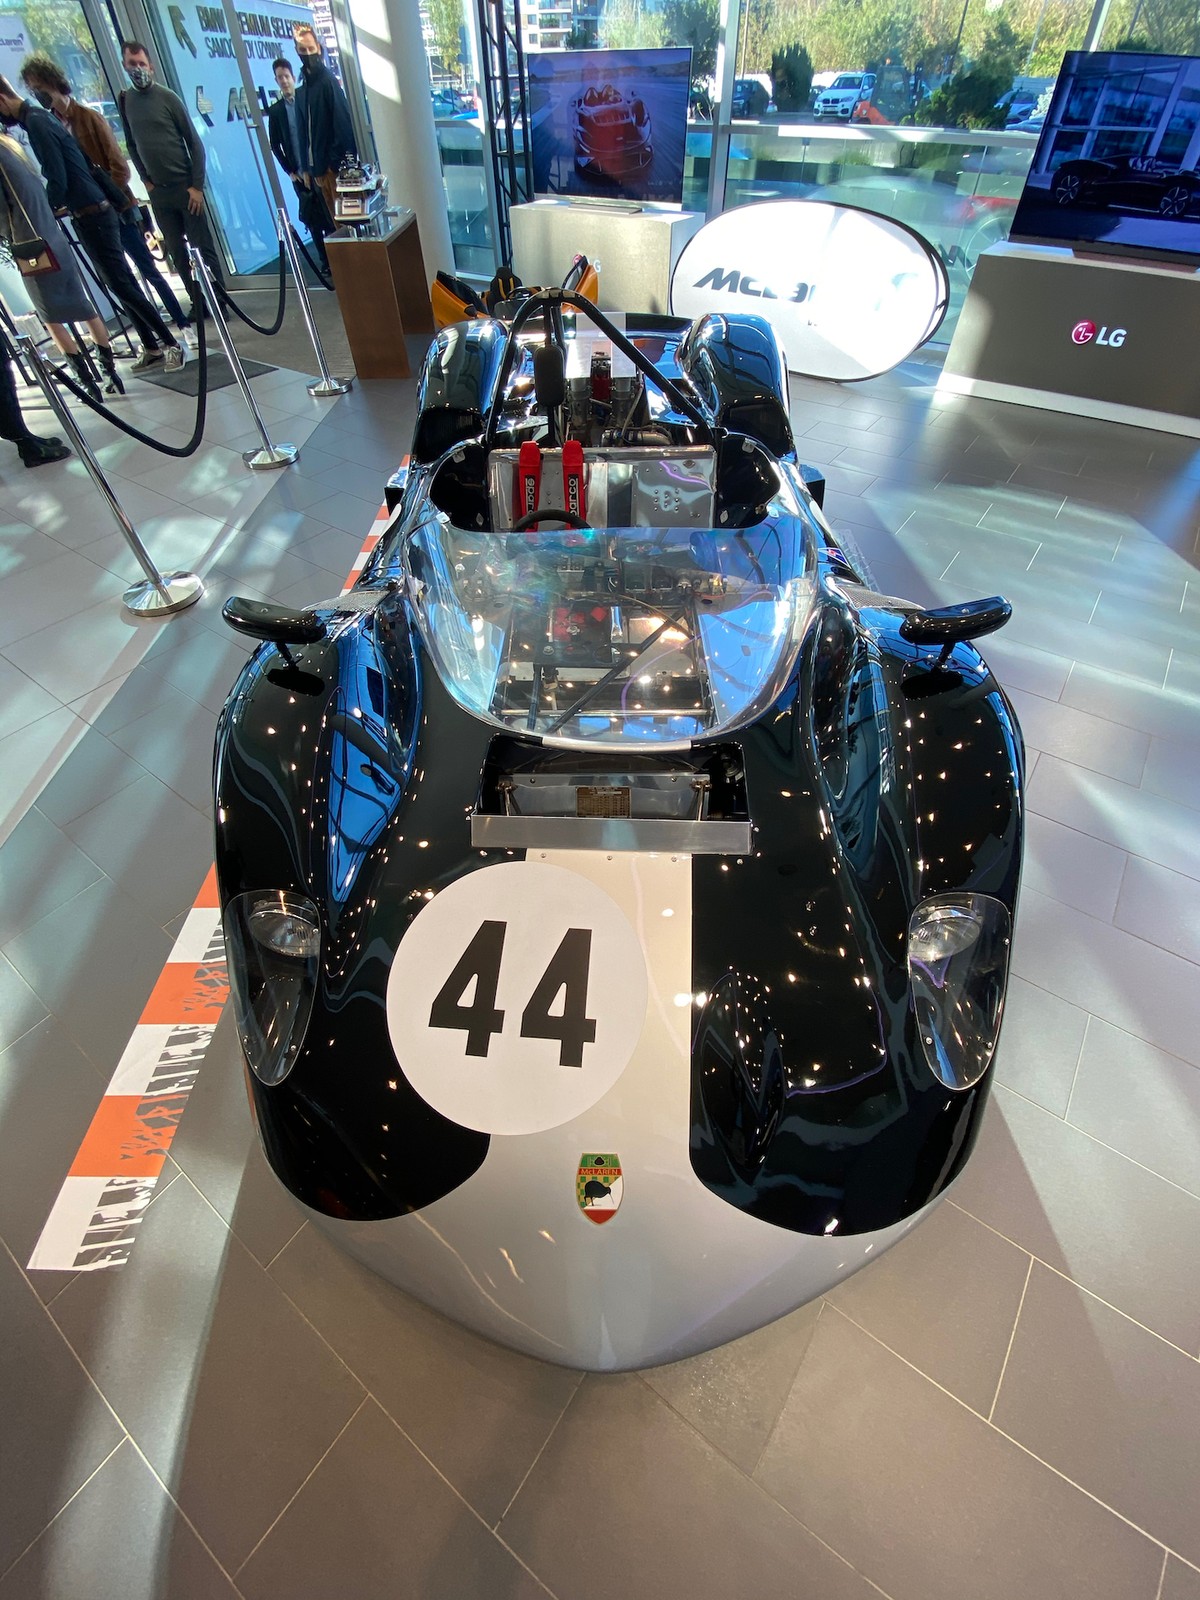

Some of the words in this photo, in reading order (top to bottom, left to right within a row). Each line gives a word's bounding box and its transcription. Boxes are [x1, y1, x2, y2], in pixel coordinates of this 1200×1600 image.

[196, 5, 227, 33] BMW
[236, 11, 272, 37] EMIUM
[1095, 326, 1127, 348] LG
[428, 919, 597, 1068] 44
